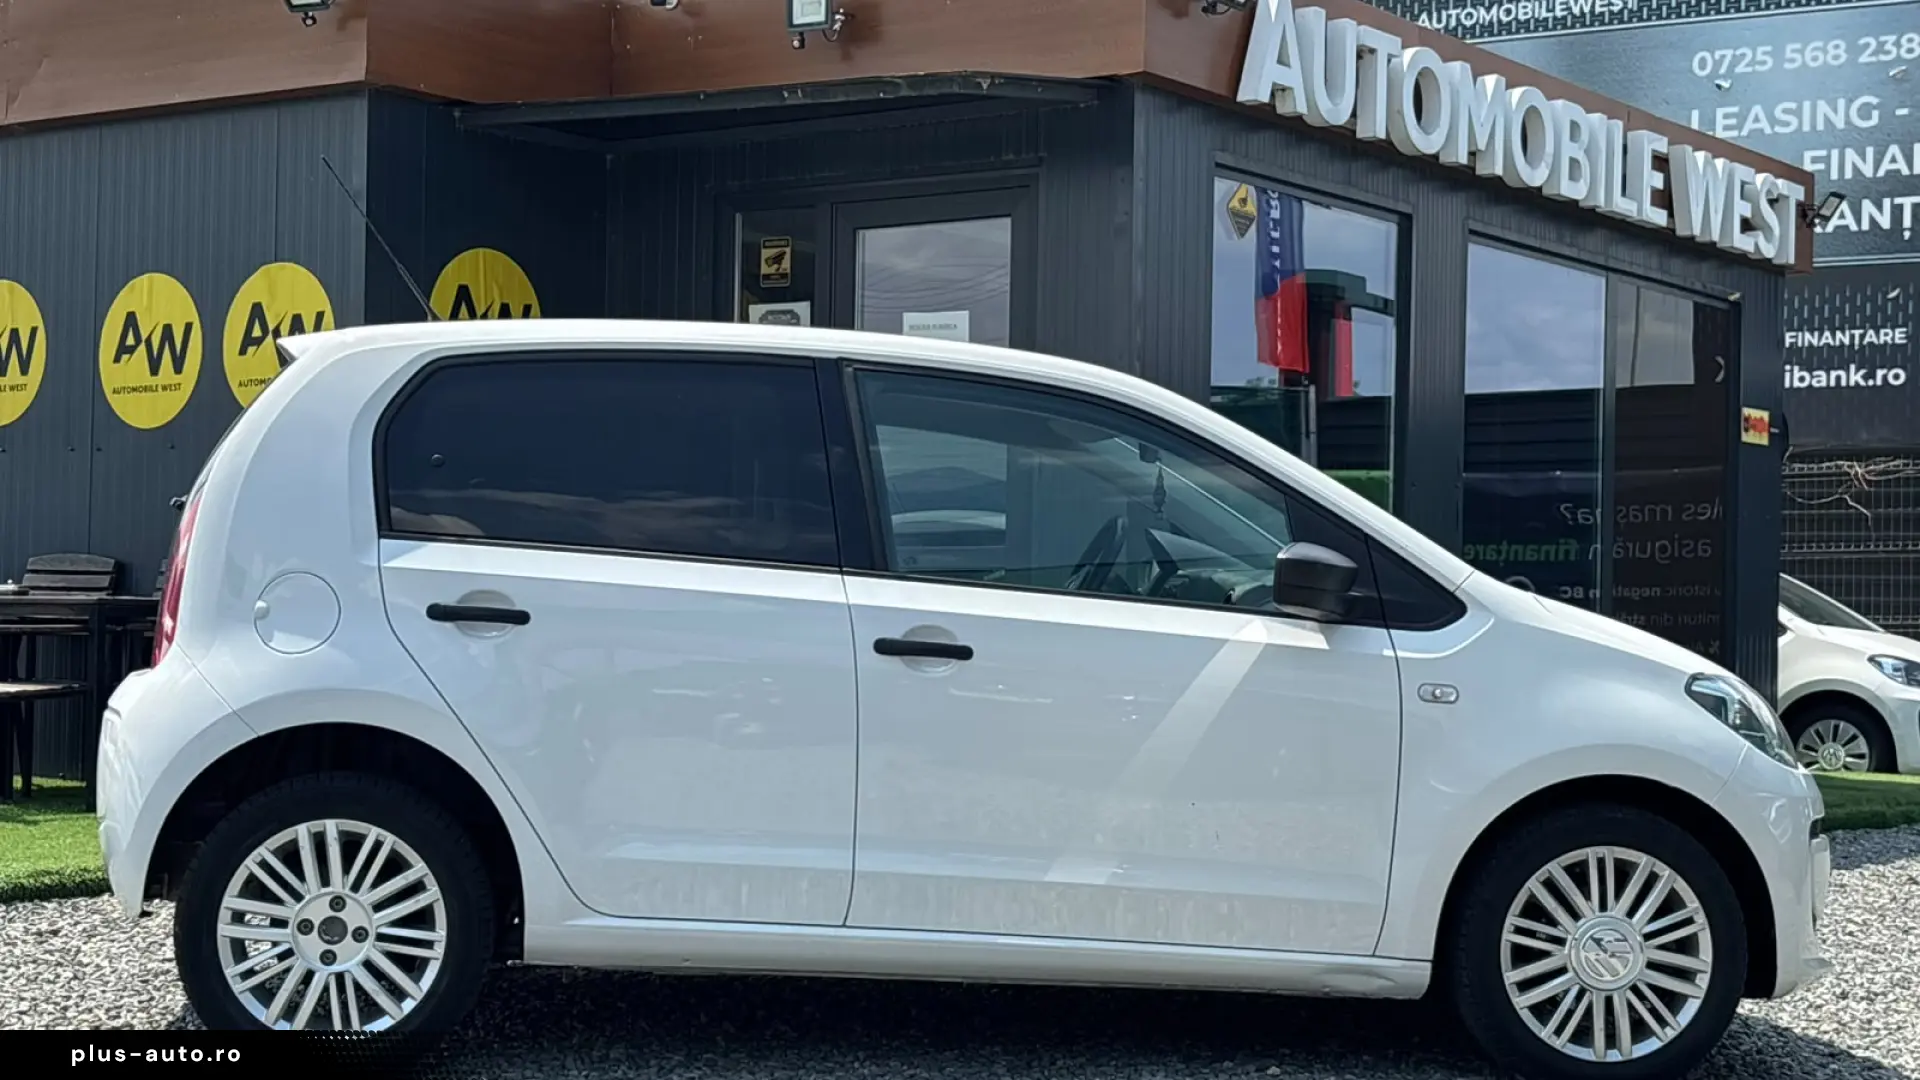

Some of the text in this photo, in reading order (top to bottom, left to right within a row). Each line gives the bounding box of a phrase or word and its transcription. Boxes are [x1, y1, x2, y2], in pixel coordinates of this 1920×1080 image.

[1692, 32, 1920, 78] 0725 568 238
[1236, 0, 1805, 265] AUTOMOBILE WEST
[1691, 95, 1880, 138] LEASING
[1814, 195, 1920, 240] ANȚ
[113, 311, 194, 377] AW
[112, 382, 182, 395] AUTOMOBILE WEST
